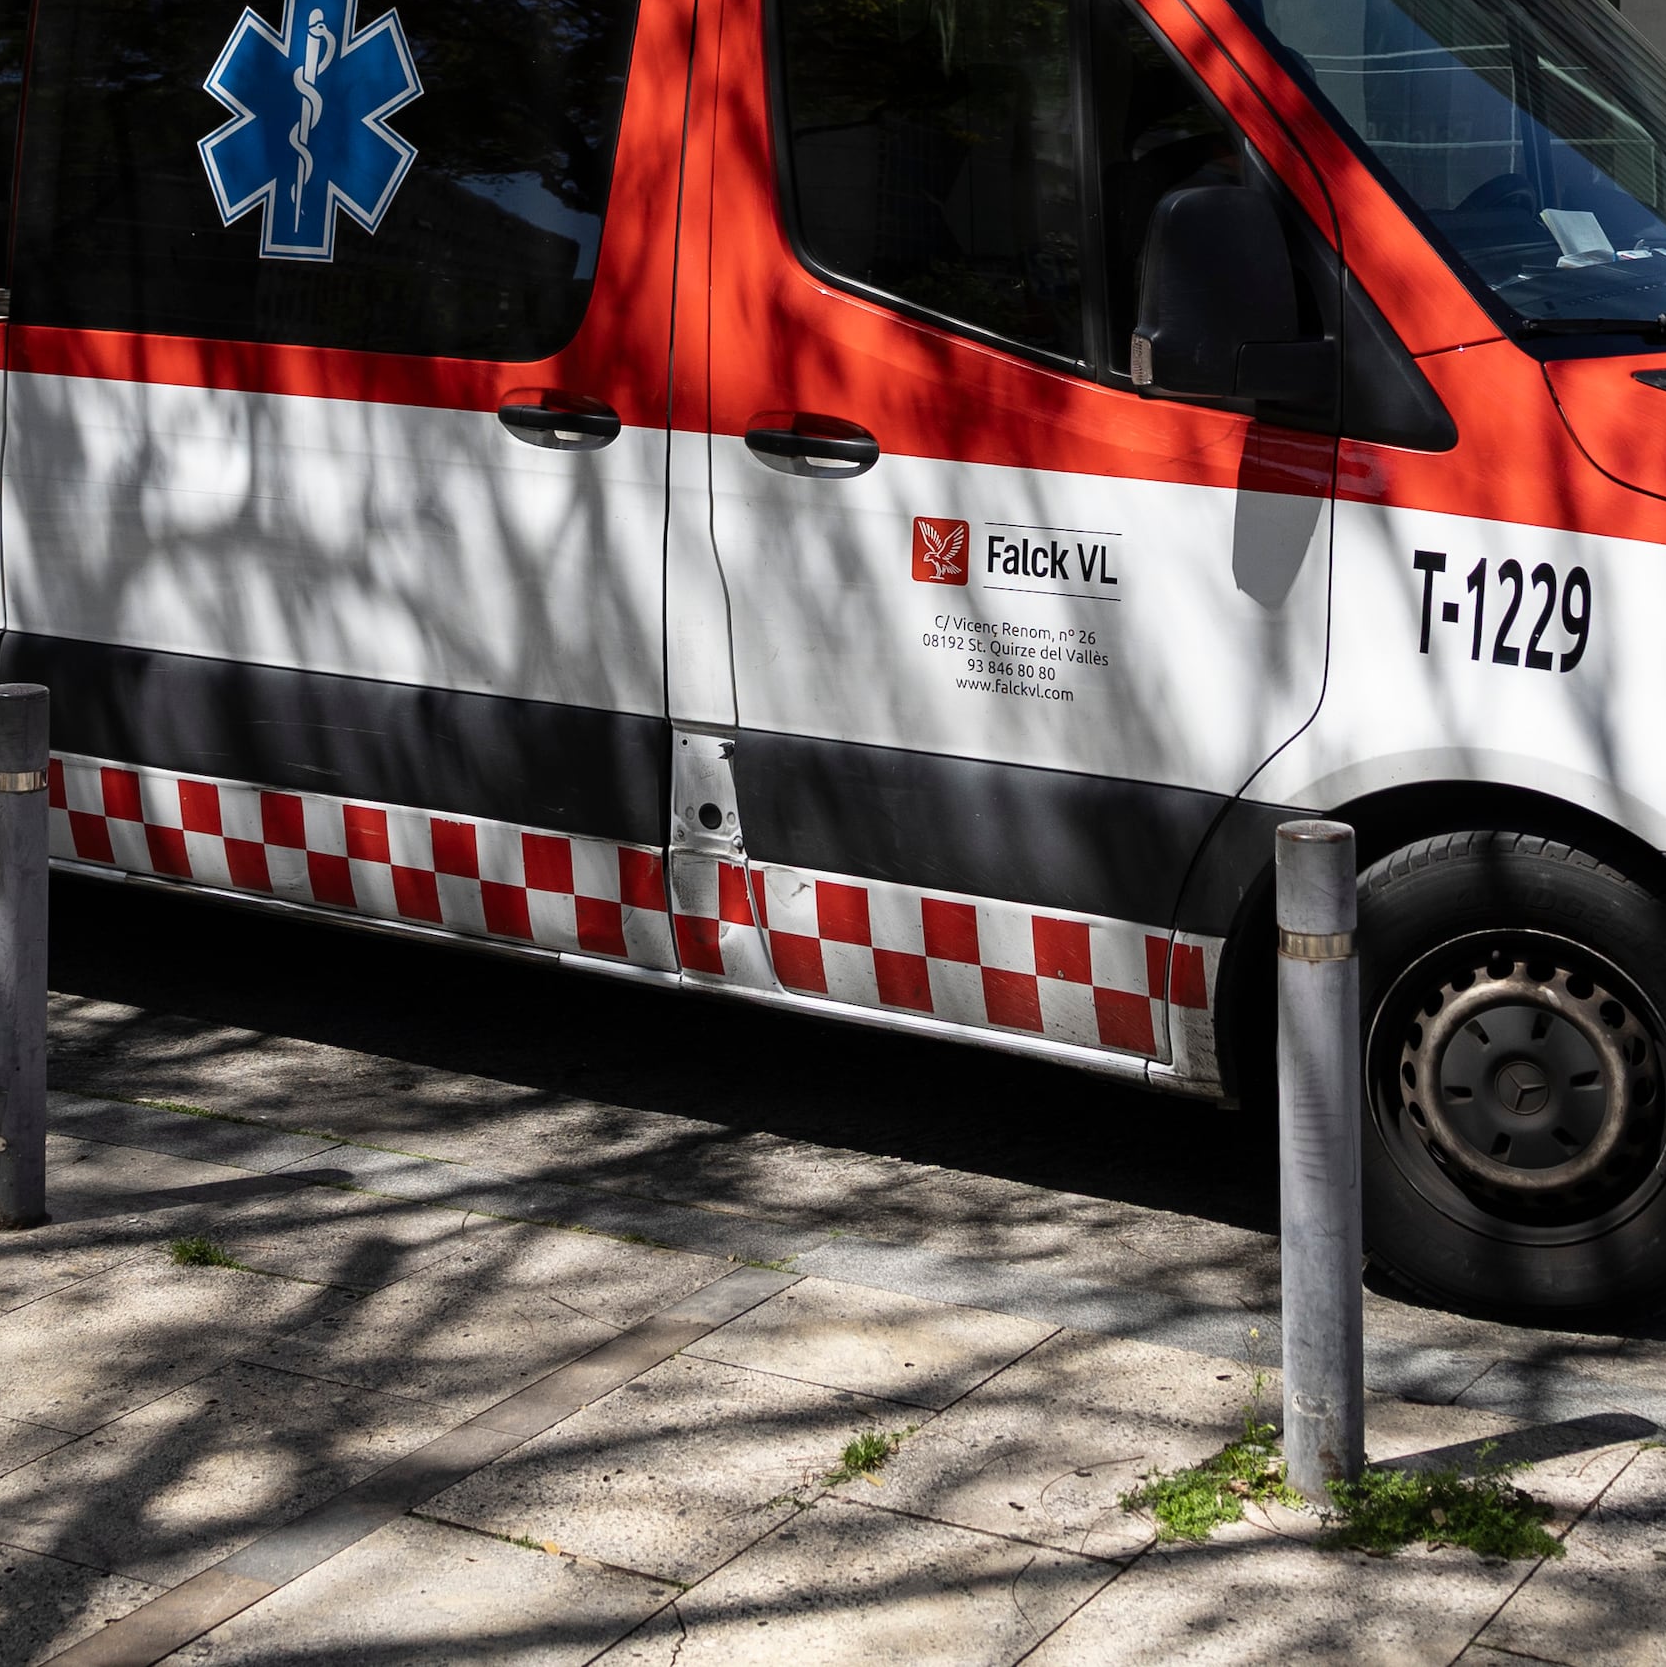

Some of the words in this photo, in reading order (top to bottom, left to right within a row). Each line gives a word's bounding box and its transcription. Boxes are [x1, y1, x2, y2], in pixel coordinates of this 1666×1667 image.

[987, 535, 1069, 580] Falck
[1077, 543, 1118, 585] VL
[1413, 549, 1592, 673] T-1229
[934, 615, 951, 632] C/
[953, 617, 998, 638] Vicenç
[1002, 622, 1056, 644] Renom,
[1079, 630, 1096, 645] 26
[922, 633, 964, 650] 08192
[968, 638, 986, 654] St.
[990, 640, 1036, 658] Quirze
[1040, 645, 1061, 661] del
[1065, 648, 1109, 666] Vallès
[967, 658, 984, 672] 93
[988, 660, 1013, 676] 846
[1017, 664, 1034, 678] 80
[1038, 666, 1055, 681] 80
[956, 677, 1074, 702] www.falckvl.com
